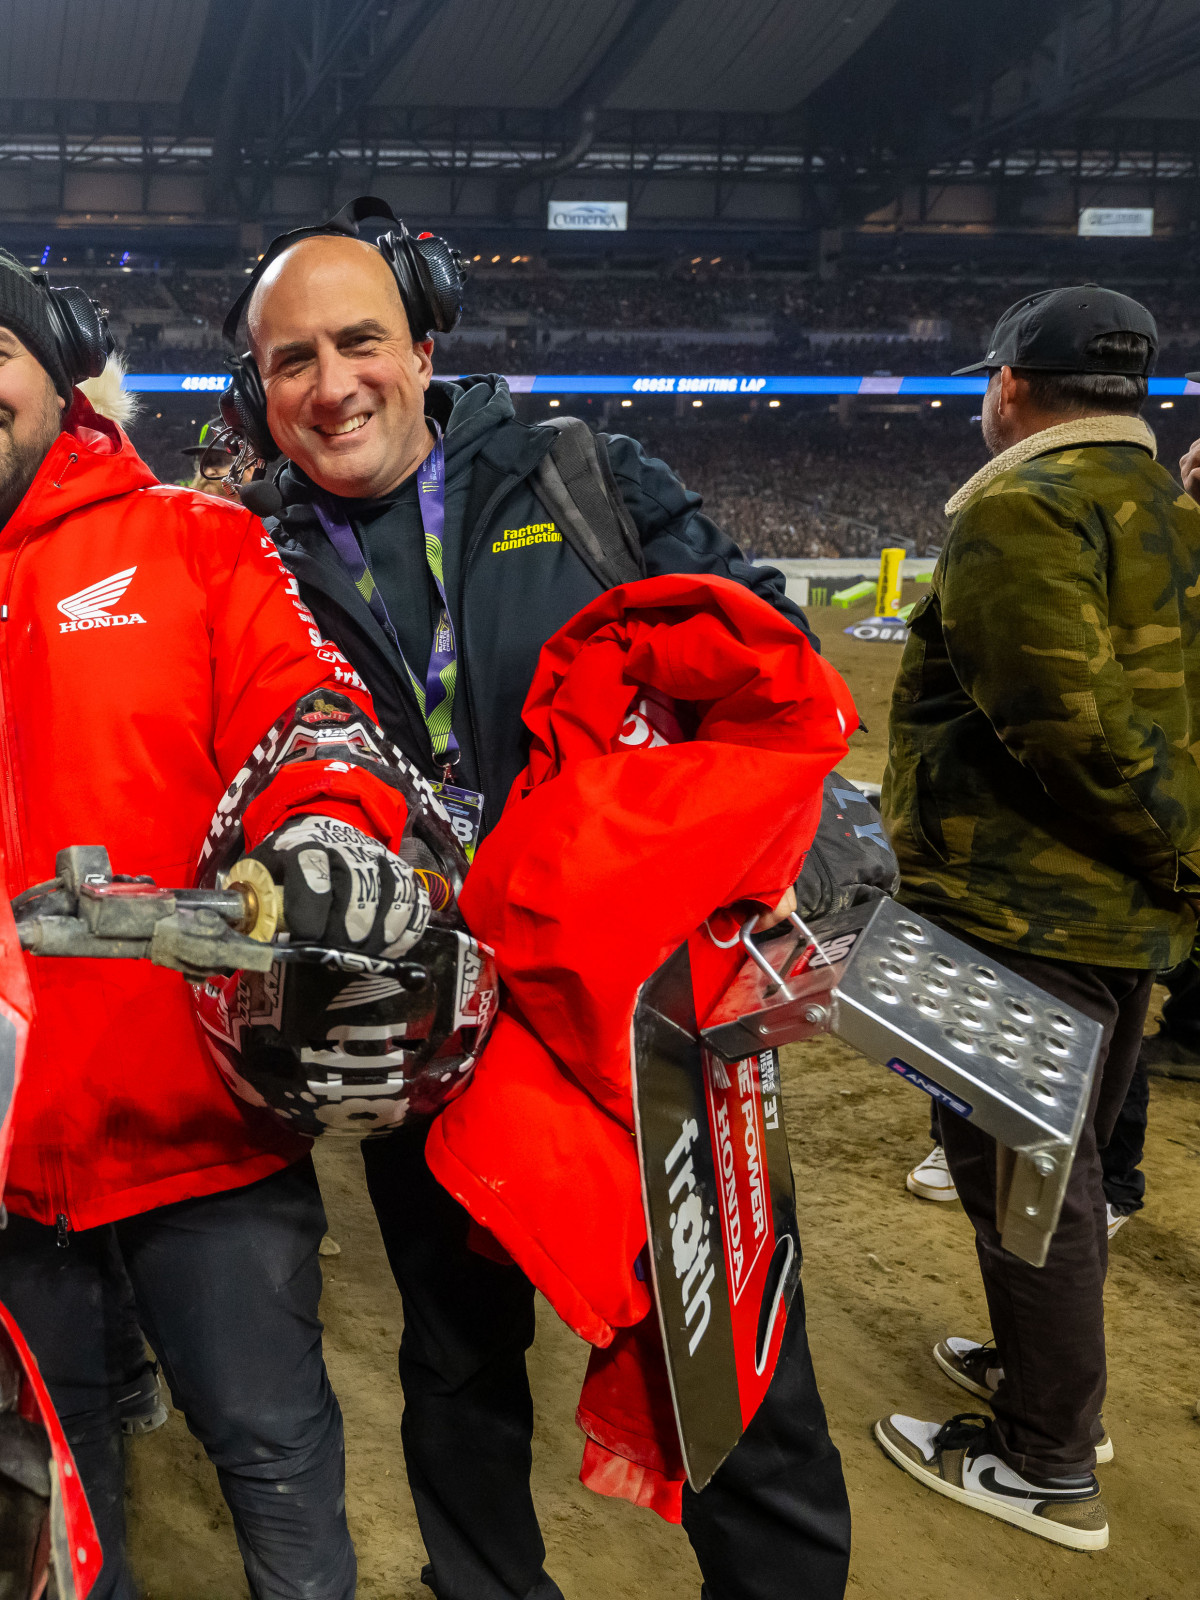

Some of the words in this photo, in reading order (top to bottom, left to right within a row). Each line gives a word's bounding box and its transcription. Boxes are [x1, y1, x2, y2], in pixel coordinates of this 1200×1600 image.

[181, 376, 226, 390] 450SX
[632, 378, 676, 392] 450SX
[677, 378, 738, 392] SIGHTING
[740, 378, 767, 392] LAP
[503, 522, 555, 541] Factory
[492, 532, 563, 553] Connection
[59, 613, 147, 633] HONDA
[763, 1094, 780, 1130] 37
[741, 1099, 766, 1240] POWER
[717, 1098, 746, 1289] HONDA
[665, 1118, 716, 1358] froth
